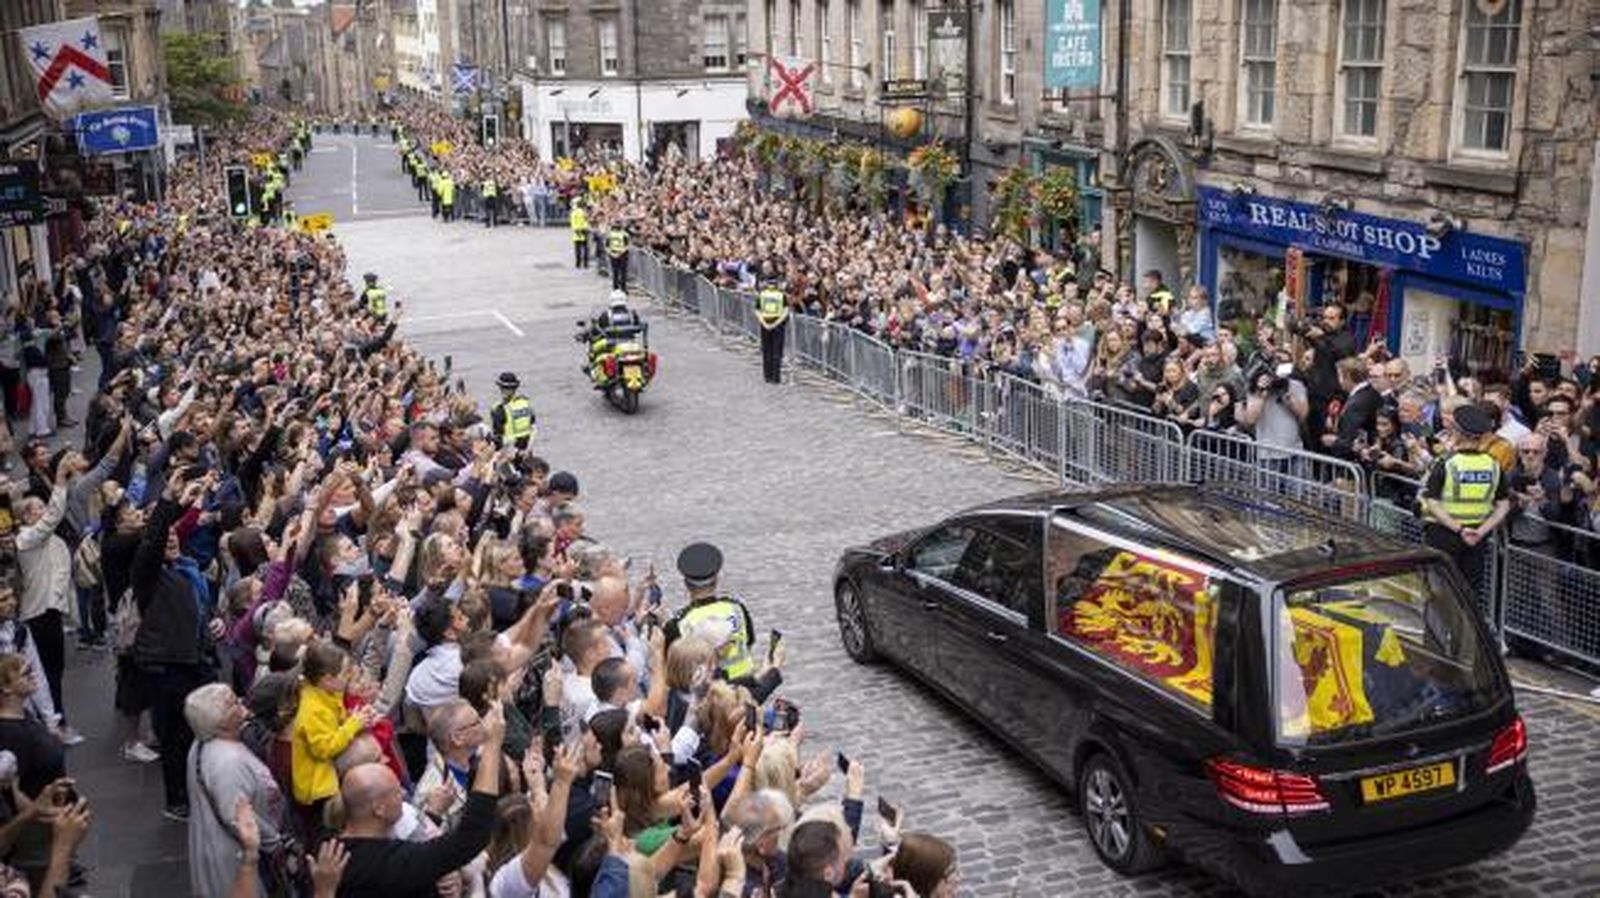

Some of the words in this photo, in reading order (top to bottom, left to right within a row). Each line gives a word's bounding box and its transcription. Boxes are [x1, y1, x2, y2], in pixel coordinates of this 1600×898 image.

[1058, 36, 1087, 50] CAFE
[1250, 203, 1312, 232] REAL
[1363, 225, 1441, 259] SHOP
[1462, 248, 1506, 265] LADIES
[1467, 263, 1503, 280] KILTS
[1374, 777, 1395, 795] WP
[1402, 767, 1442, 789] 4597
